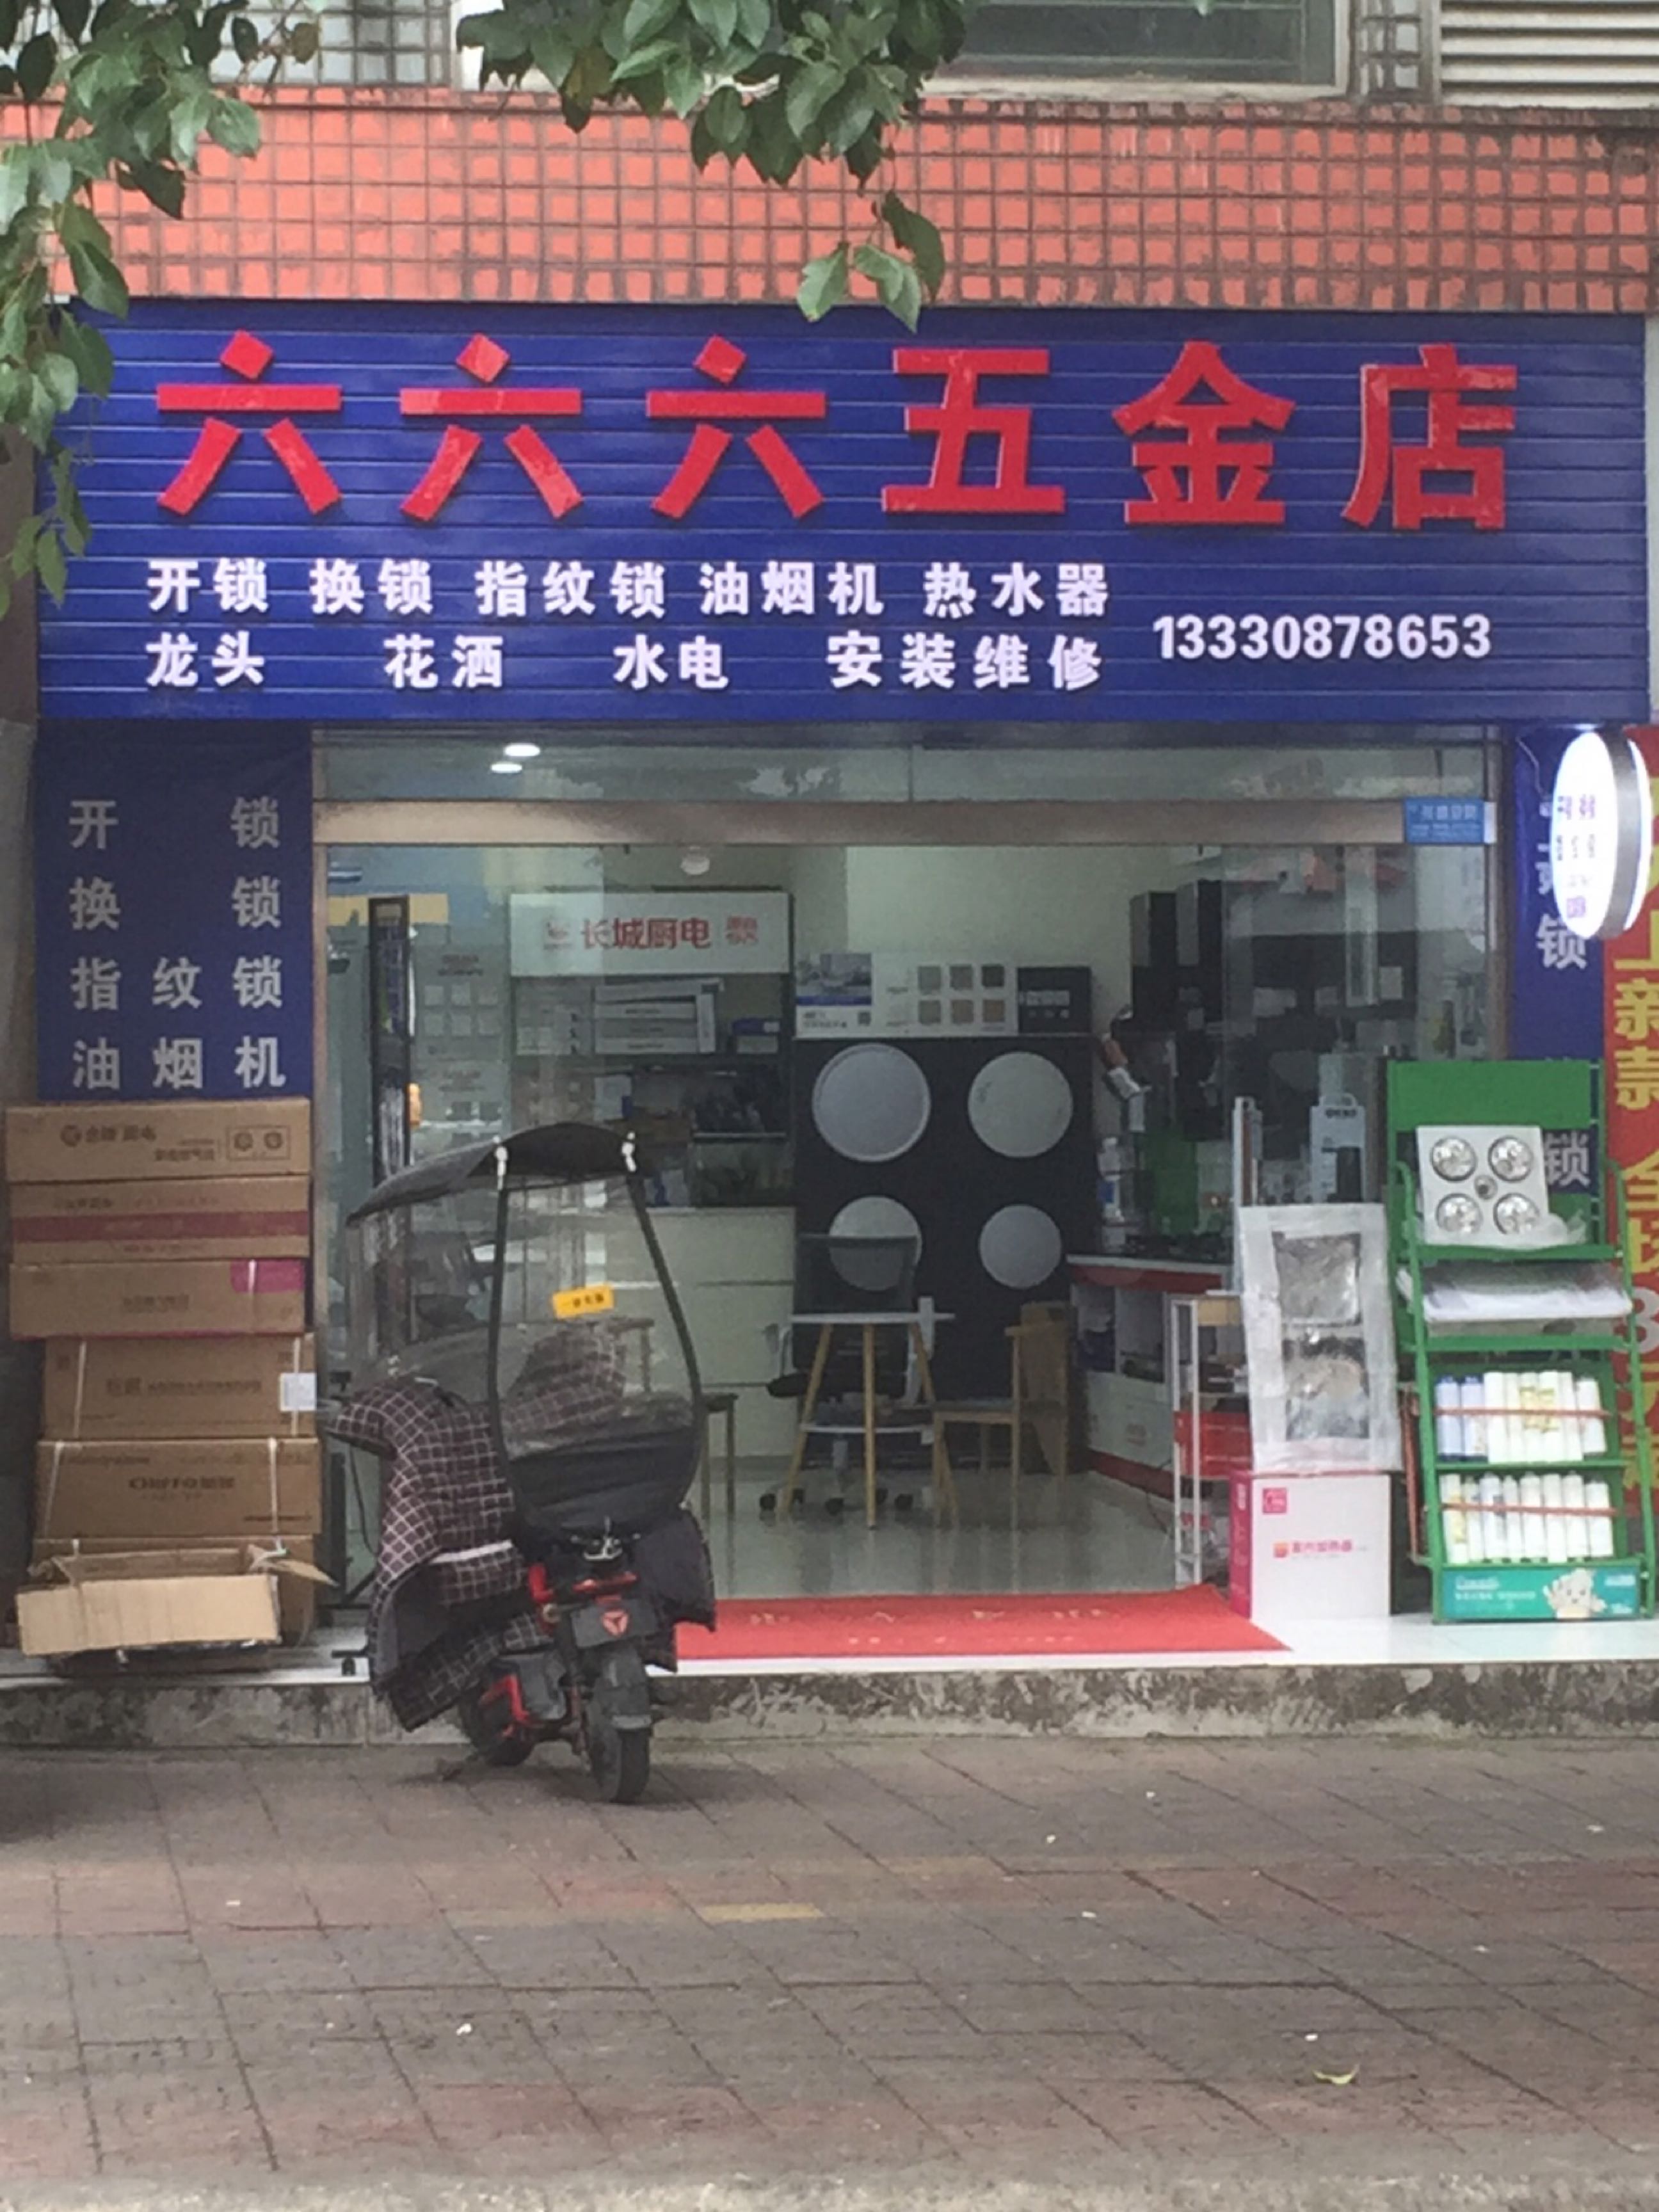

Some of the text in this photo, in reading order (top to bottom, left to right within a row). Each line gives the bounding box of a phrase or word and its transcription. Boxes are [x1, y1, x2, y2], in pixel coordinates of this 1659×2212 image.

[156, 330, 1518, 529] 六六六五金店
[147, 556, 1109, 619] 开锁 换锁 指纹锁 油烟机 热水器
[145, 630, 1102, 691] 龙头 花洒 水电 安装维修
[1153, 613, 1491, 659] 13330878653
[69, 796, 280, 849] 开锁
[69, 875, 282, 930] 换锁
[582, 917, 712, 949] 长城厨电
[70, 956, 283, 1011] 指纹锁
[73, 1035, 287, 1090] 油烟机
